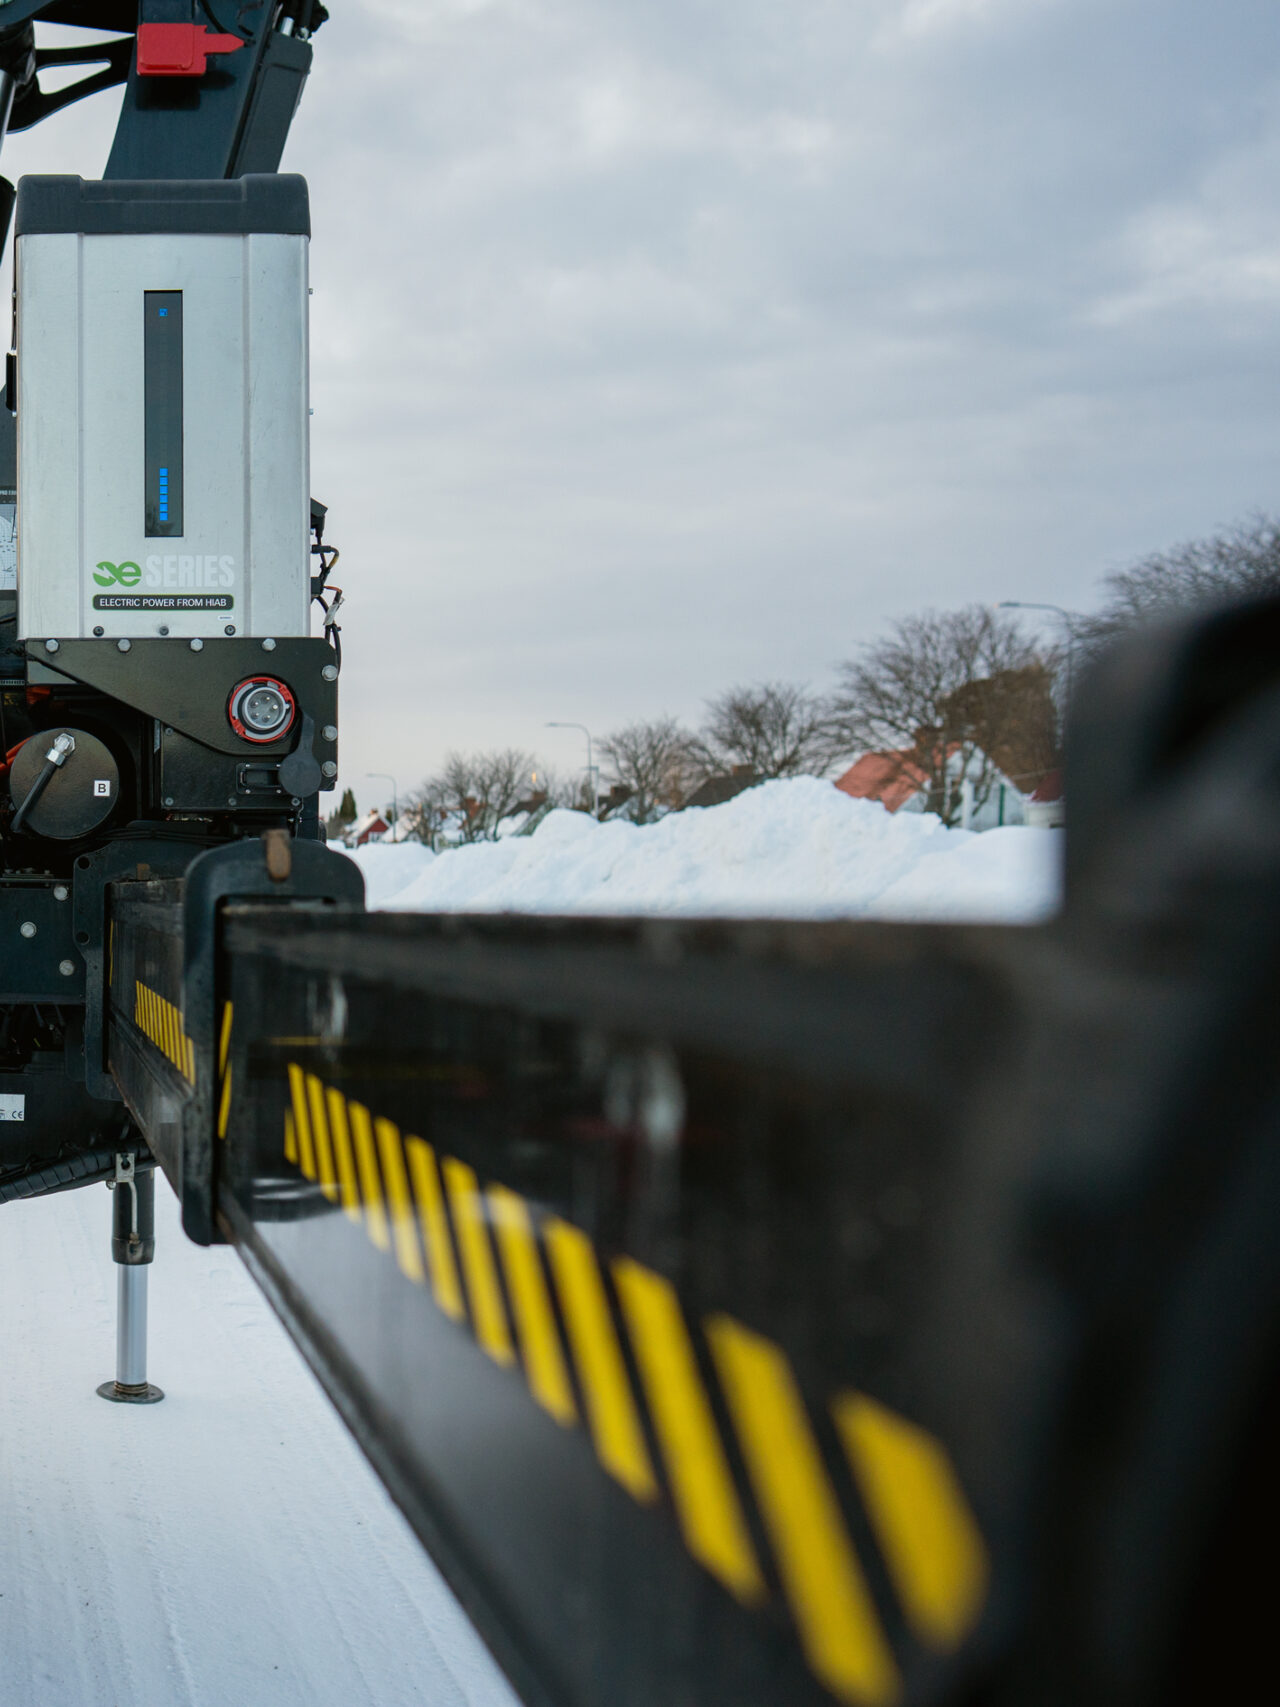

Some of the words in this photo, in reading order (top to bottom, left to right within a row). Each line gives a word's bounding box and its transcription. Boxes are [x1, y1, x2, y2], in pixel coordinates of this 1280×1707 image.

[146, 554, 234, 588] SERIES
[99, 598, 141, 607] ELECTRIC
[142, 598, 175, 607] POWER
[177, 598, 203, 607] FROM
[205, 598, 227, 607] HIAB
[98, 783, 107, 793] B
